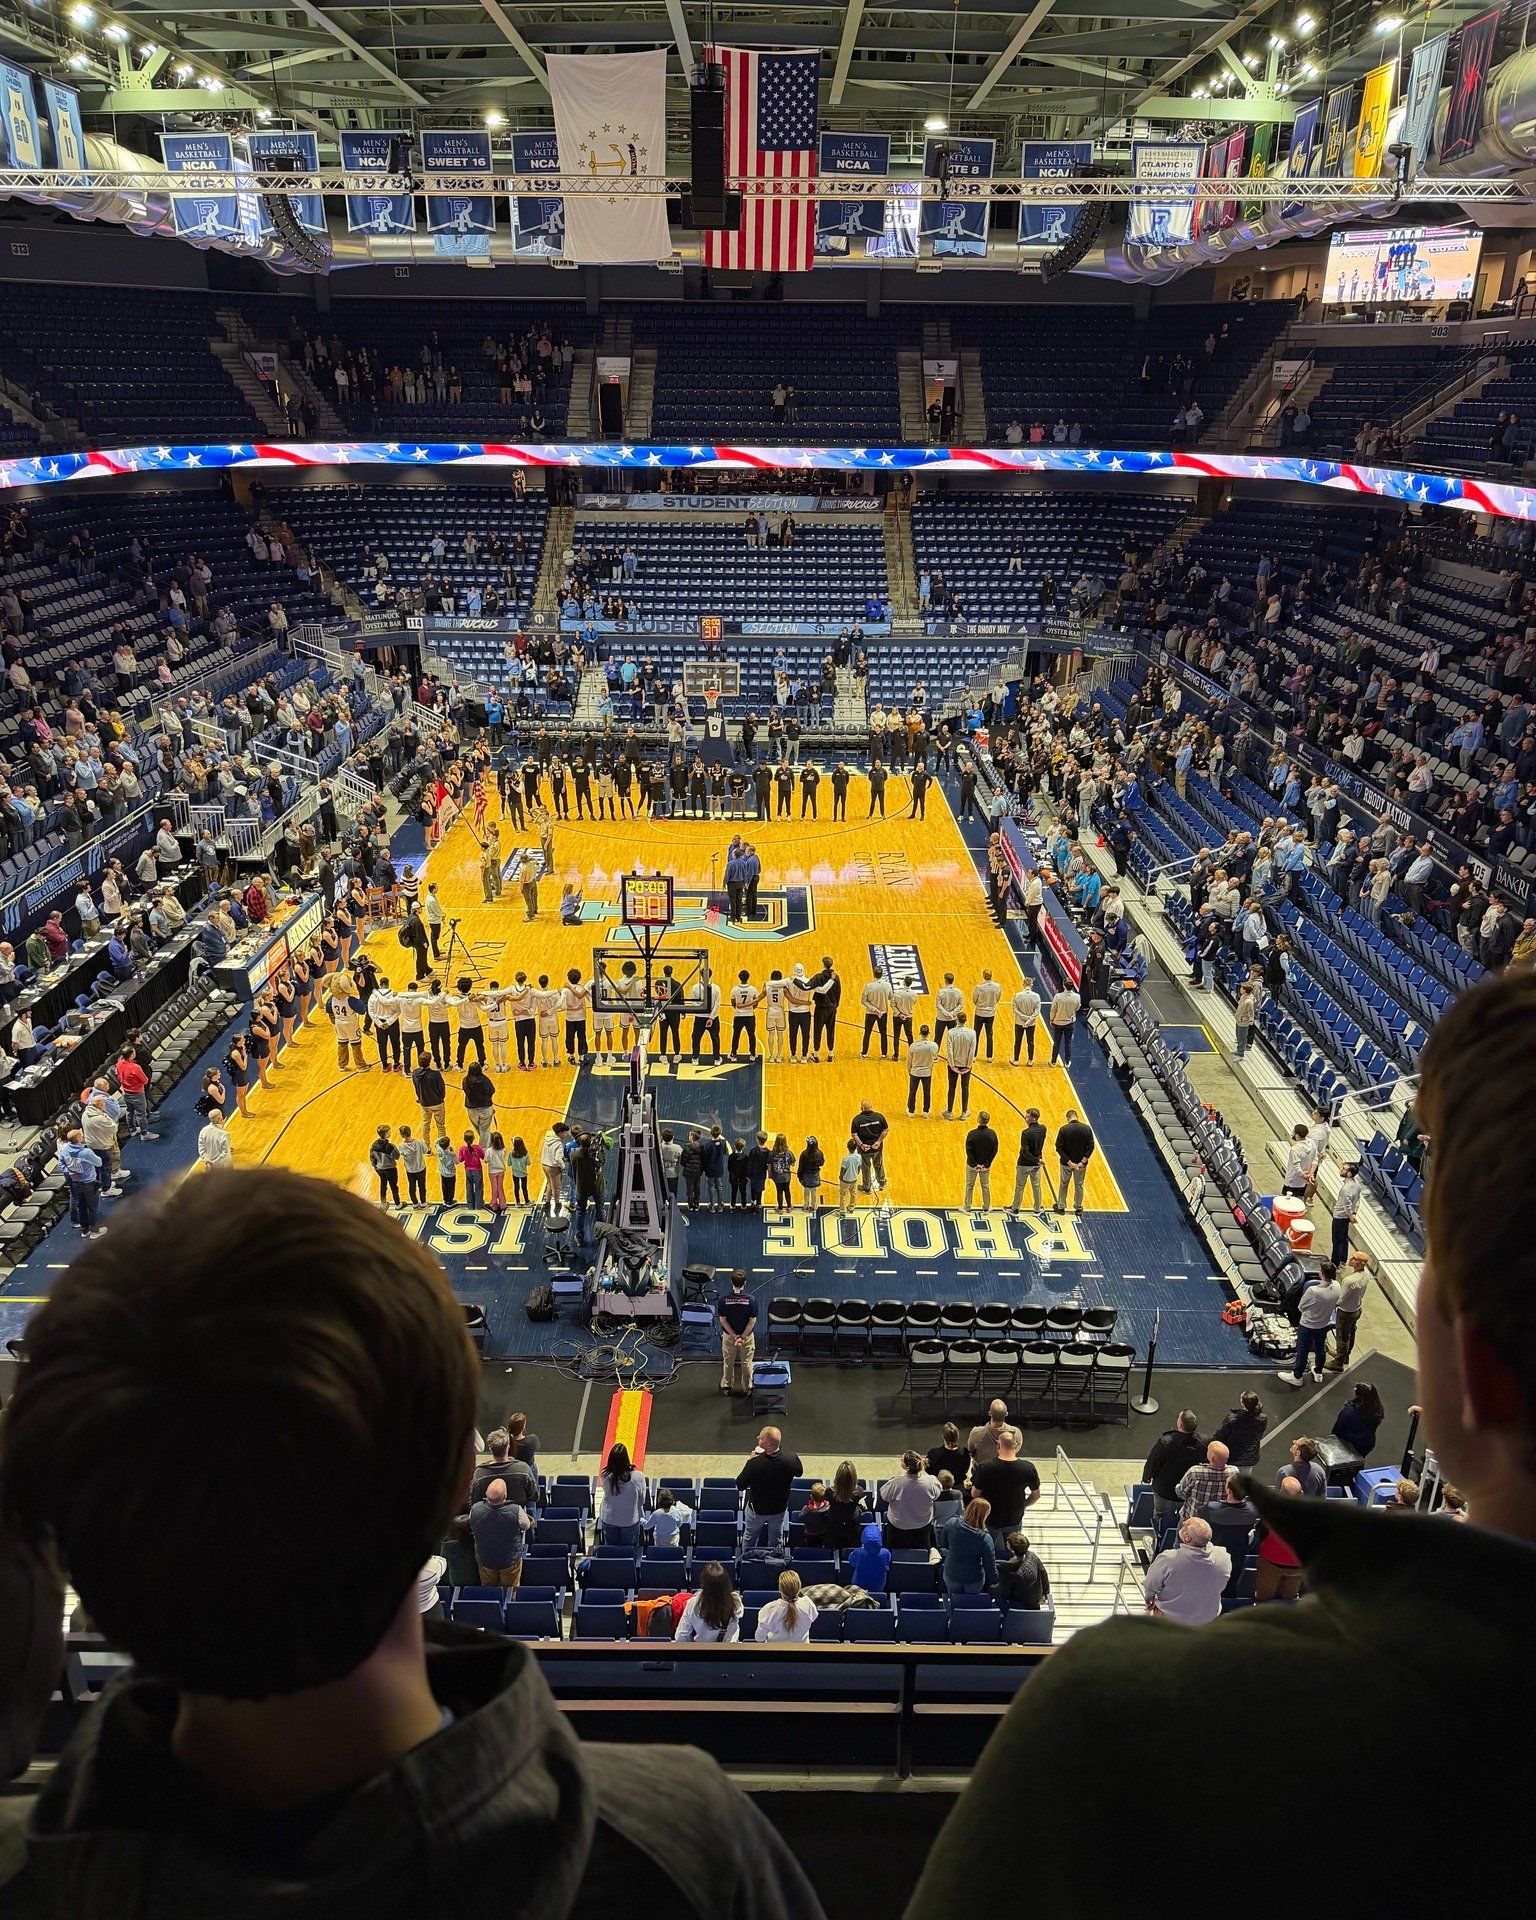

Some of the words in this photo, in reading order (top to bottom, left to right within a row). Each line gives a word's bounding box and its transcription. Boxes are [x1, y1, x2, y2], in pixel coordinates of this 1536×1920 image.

[14, 117, 29, 144] 20
[64, 135, 74, 159] 11
[185, 142, 209, 151] MEN'S
[270, 141, 295, 149] MEN'S
[444, 139, 468, 147] MEN'S
[843, 142, 867, 150] MEN'S
[175, 150, 222, 159] BASKETBALL
[524, 148, 558, 157] BASKETB
[831, 149, 878, 158] BASKETBALL
[1045, 150, 1070, 158] MEN'S
[182, 161, 217, 170] NCAA
[427, 157, 468, 167] SWEET
[472, 157, 486, 167] 16
[836, 160, 871, 170] NCAA
[971, 165, 980, 175] 8
[885, 214, 912, 224] 018
[12, 243, 28, 255] 313
[395, 267, 409, 277] 314
[1431, 326, 1448, 337] 303
[663, 497, 750, 509] STUDENT
[747, 497, 799, 510] SECTION
[844, 499, 880, 510] RUCKUS
[364, 611, 401, 622] MATUNUCK
[702, 618, 720, 626] 20:00
[364, 621, 388, 630] OYSTER
[389, 620, 402, 628] BAR
[408, 617, 423, 629] 114
[434, 618, 451, 628] BRING
[459, 618, 499, 629] RUCKUS
[614, 621, 699, 632] STUDEN
[749, 622, 799, 634] SECTION
[1047, 618, 1081, 629] MATUNUCK
[704, 626, 718, 638] 30
[967, 624, 977, 634] THE
[977, 624, 997, 634] RHODY
[997, 624, 1011, 634] WAY
[1045, 627, 1068, 636] OYSTER
[1182, 668, 1200, 686] BRING
[1200, 678, 1212, 694] THE
[711, 724, 719, 732] D
[1324, 760, 1354, 789] WELCOME
[1354, 780, 1363, 797] TO
[1363, 787, 1386, 813] RHODY
[1386, 801, 1412, 831] NATION
[853, 851, 877, 886] CENTER
[878, 852, 914, 886] RYAN
[42, 877, 62, 899] STREET
[60, 864, 81, 885] MARKET
[627, 880, 666, 894] 20:00
[633, 895, 661, 918] 30
[741, 995, 748, 1004] 7
[772, 993, 779, 1003] 5
[334, 1005, 347, 1016] 34
[763, 1209, 1097, 1262] RHODE
